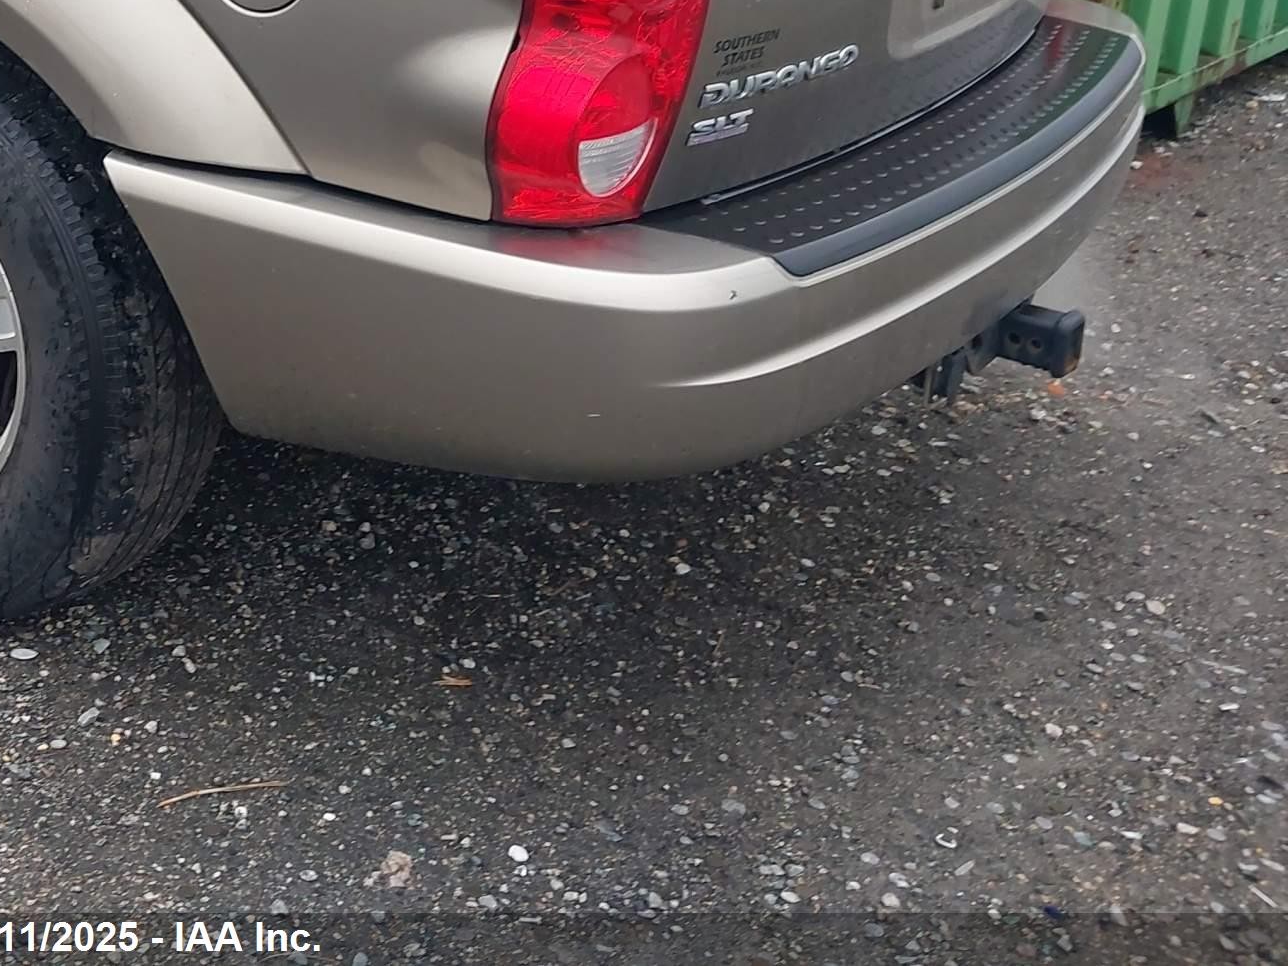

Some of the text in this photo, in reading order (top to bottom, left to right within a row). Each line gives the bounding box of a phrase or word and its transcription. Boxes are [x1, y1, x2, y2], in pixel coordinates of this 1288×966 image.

[713, 28, 781, 54] SOUTHERN
[720, 45, 765, 67] STATES
[698, 43, 860, 109] DURANGO
[689, 107, 755, 140] SLT
